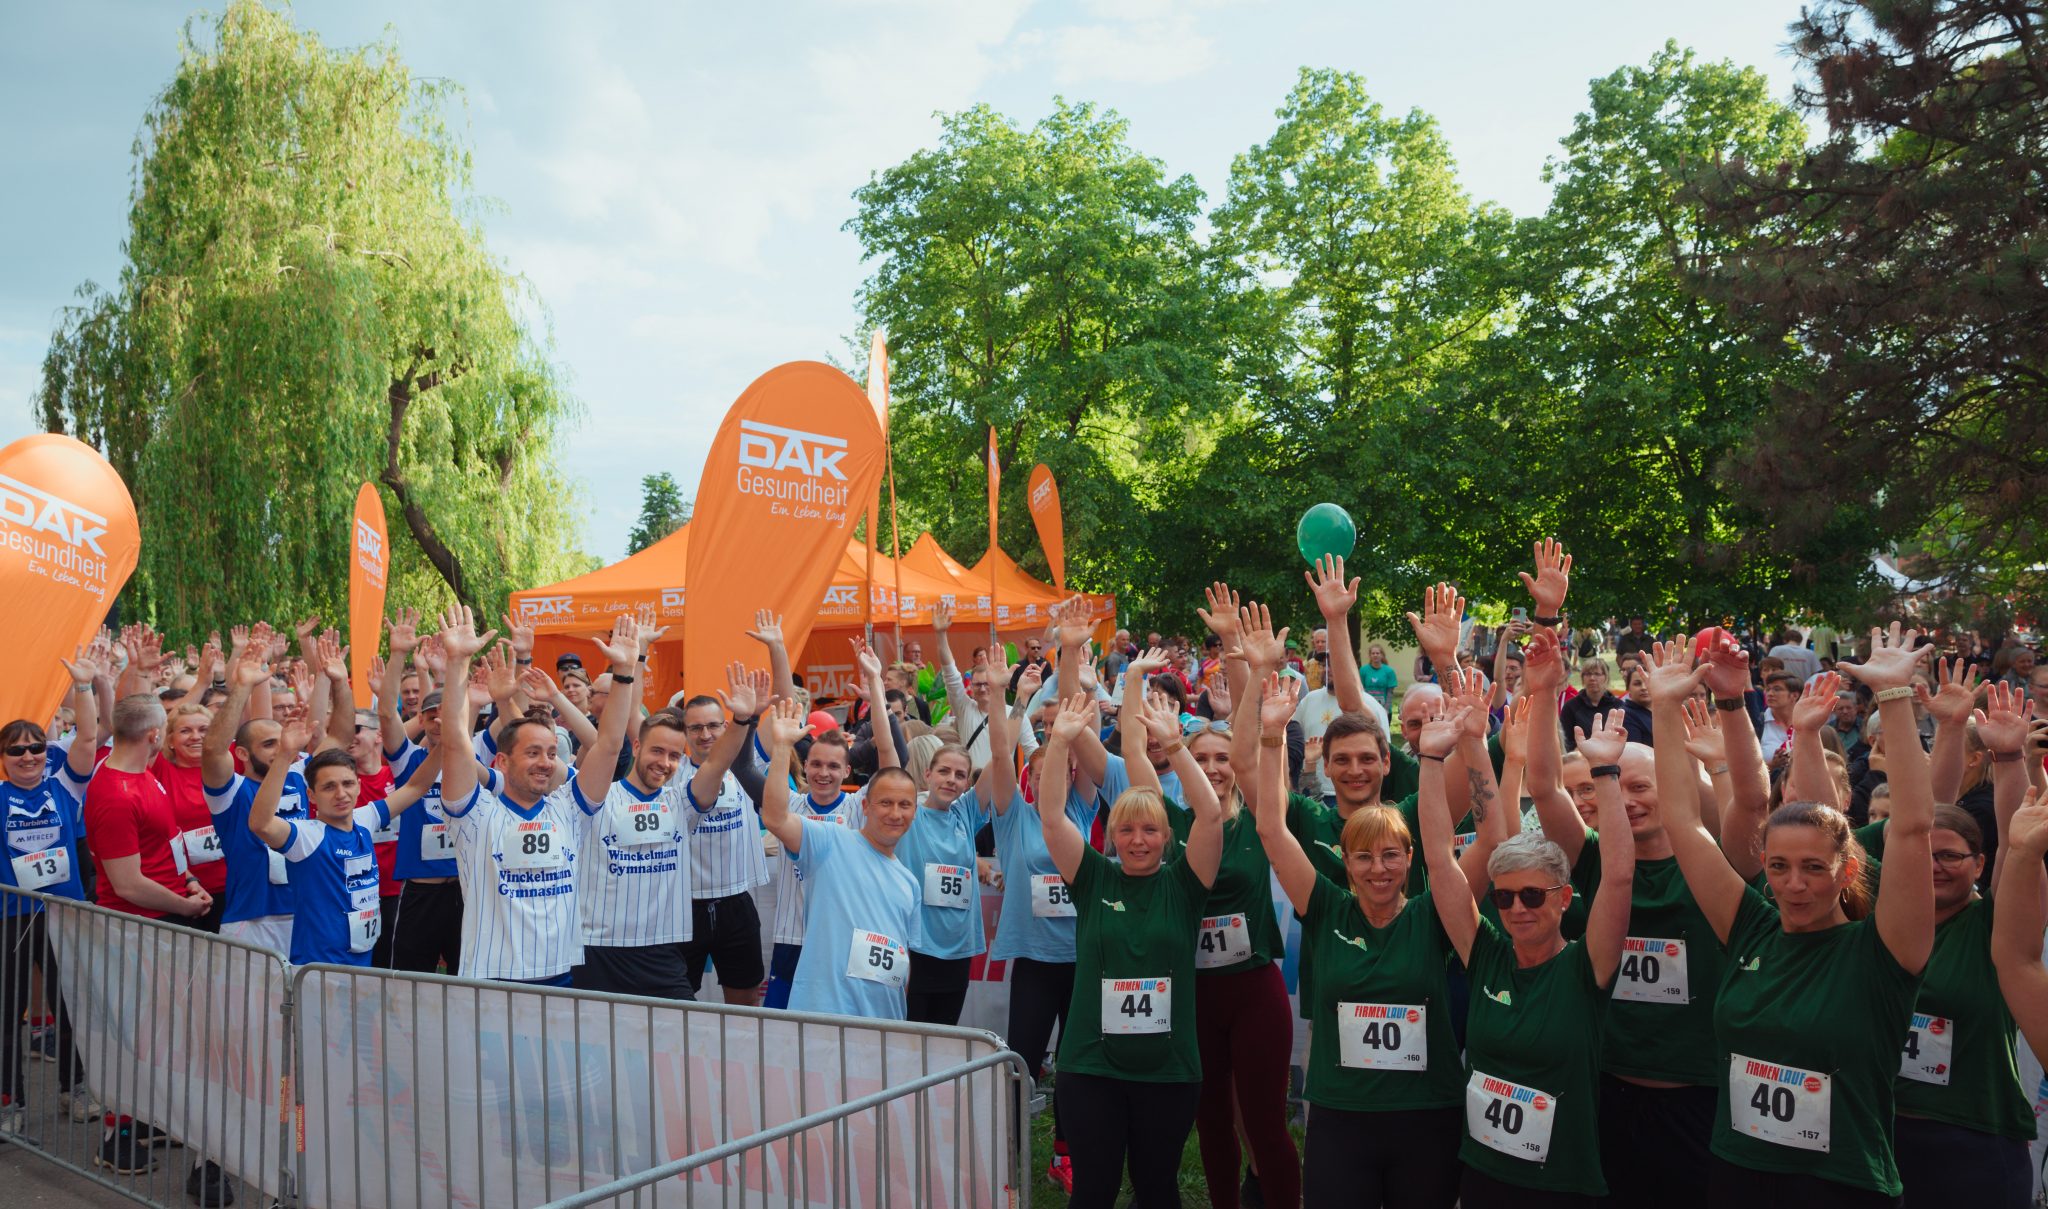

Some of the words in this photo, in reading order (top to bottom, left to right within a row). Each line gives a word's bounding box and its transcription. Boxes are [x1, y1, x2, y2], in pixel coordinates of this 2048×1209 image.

[739, 419, 848, 481] DAK
[737, 466, 849, 506] Gesundheit
[0, 474, 108, 557] DAK
[771, 502, 789, 516] Ein
[794, 505, 821, 519] Leben
[357, 518, 382, 563] DAK
[28, 560, 48, 576] Ein
[52, 569, 80, 587] Leben
[519, 595, 574, 616] DAK
[582, 604, 600, 613] Ein
[604, 602, 630, 613] Leben
[806, 664, 854, 699] DAK
[19, 819, 49, 828] Turbine
[634, 813, 660, 832] 89
[26, 833, 54, 841] MERCER
[522, 832, 550, 854] 89
[336, 848, 352, 857] JAKO
[609, 848, 678, 862] Winckelmann
[32, 859, 57, 877] 13
[609, 861, 676, 876] Gymnasium
[498, 883, 573, 898] Gymnasium
[941, 876, 962, 896] 55
[1049, 886, 1073, 905] 55
[364, 919, 378, 939] 12
[1200, 930, 1227, 954] 41
[869, 945, 894, 970] 55
[1622, 955, 1660, 984] 40
[1114, 980, 1157, 992] FIRMENLAUF
[1663, 987, 1681, 995] -159
[1121, 993, 1153, 1018] 44
[1355, 1005, 1408, 1019] FIRMENLAUF
[1363, 1022, 1401, 1051] 40
[1404, 1054, 1420, 1062] -160
[1746, 1060, 1806, 1087] FIRMENLAUF
[1921, 1066, 1942, 1075] -17
[1483, 1077, 1536, 1104] FIRMENLAUF
[1751, 1083, 1795, 1123] 40
[1485, 1098, 1524, 1135] 40
[1798, 1129, 1820, 1140] -157
[1522, 1142, 1541, 1153] -158
